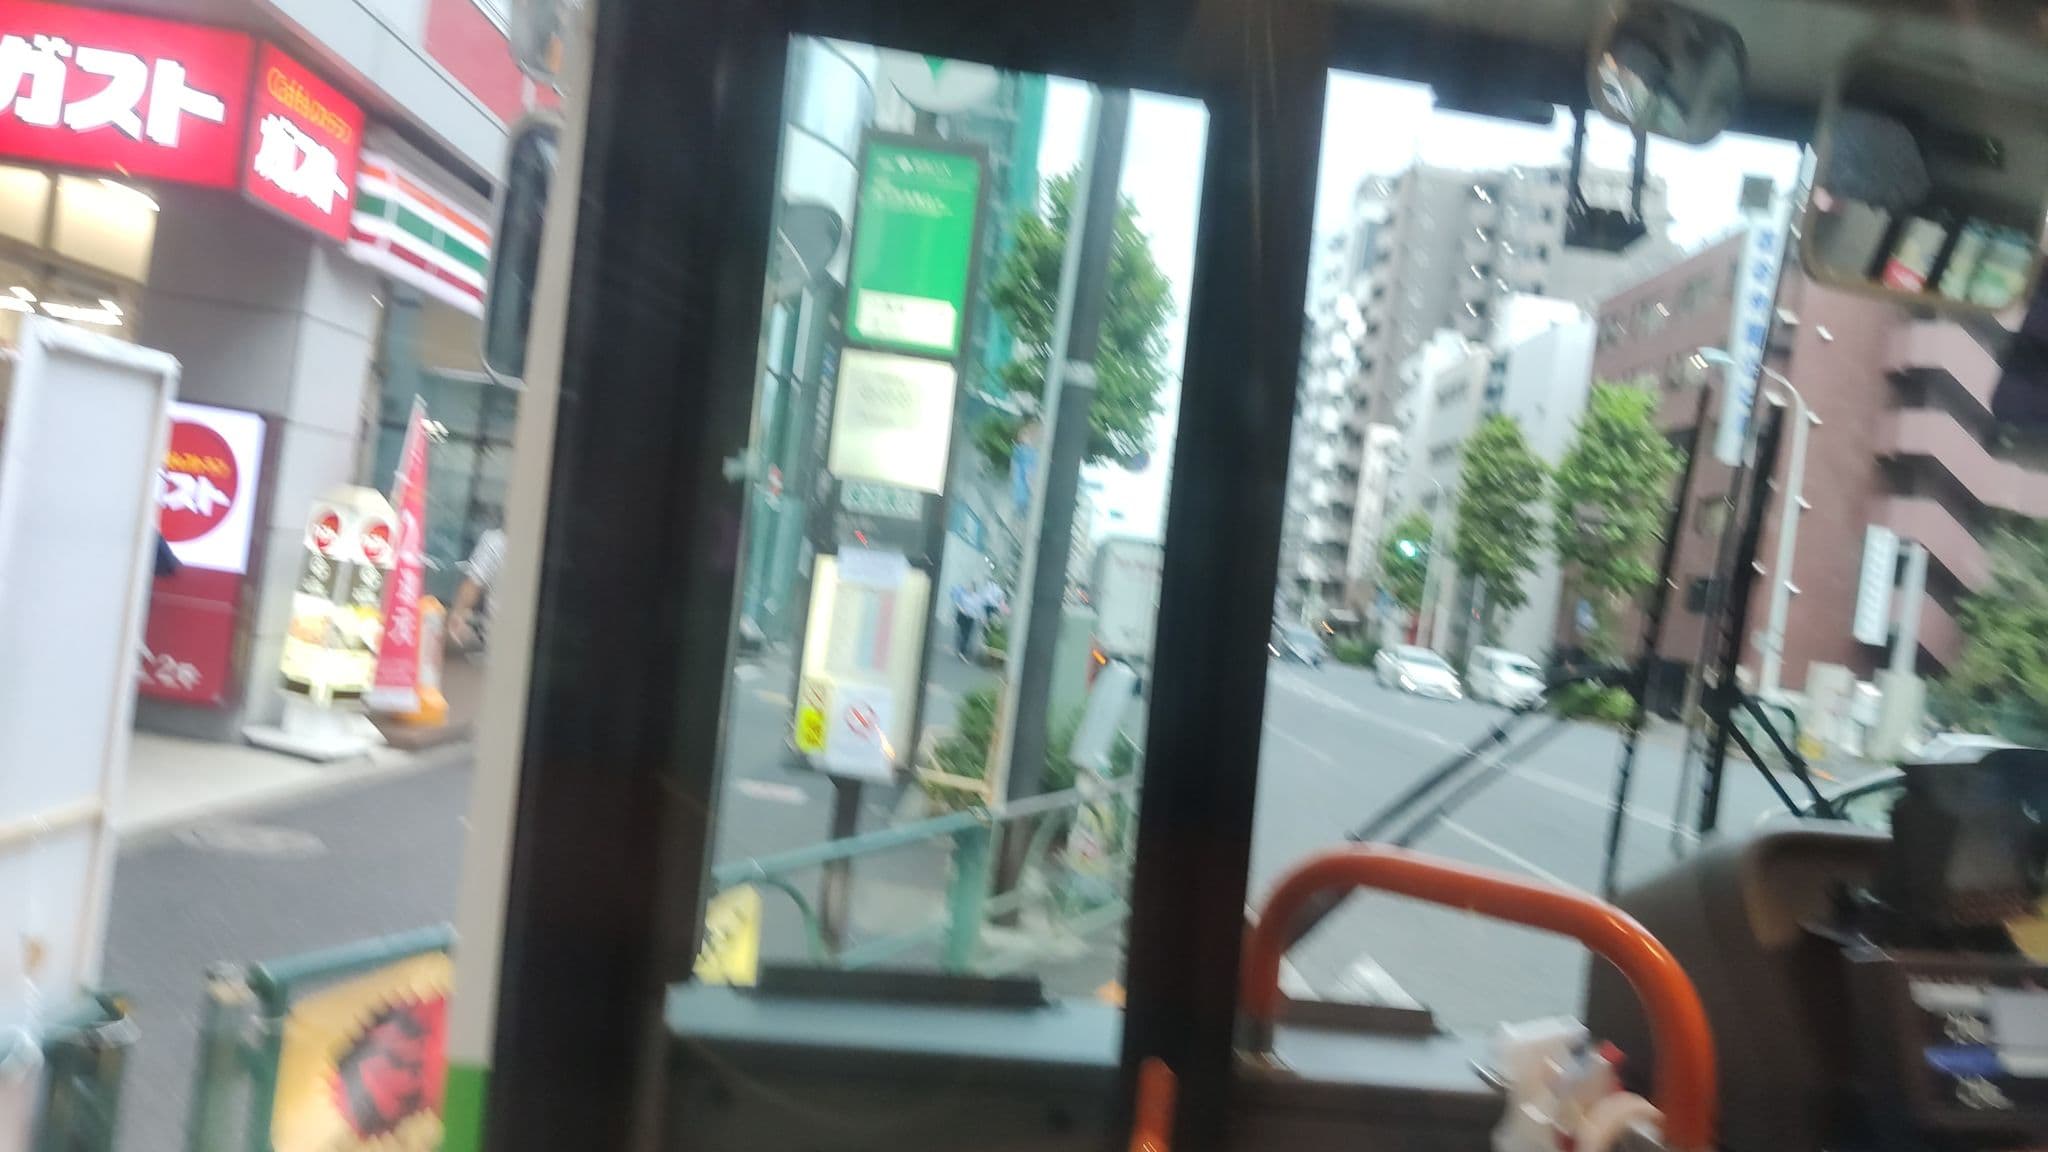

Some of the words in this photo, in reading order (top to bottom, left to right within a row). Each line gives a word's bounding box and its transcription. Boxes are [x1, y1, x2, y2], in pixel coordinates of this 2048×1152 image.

[0, 34, 226, 147] ガスト
[253, 113, 350, 216] ガスト
